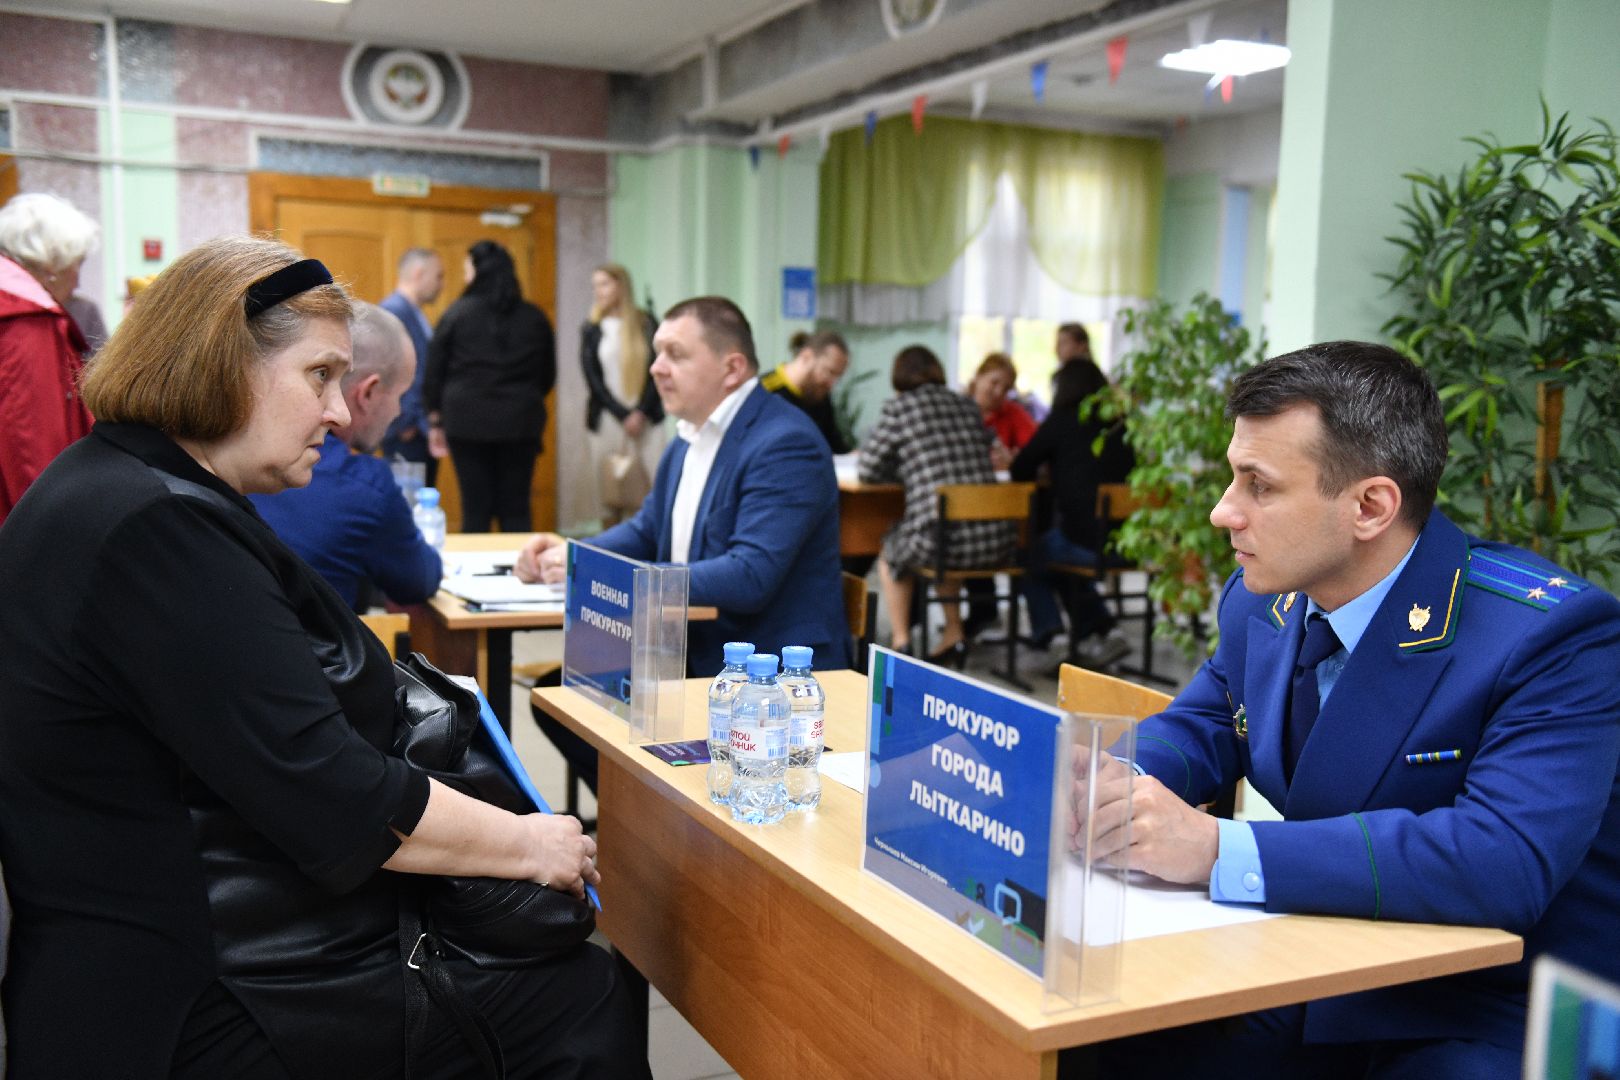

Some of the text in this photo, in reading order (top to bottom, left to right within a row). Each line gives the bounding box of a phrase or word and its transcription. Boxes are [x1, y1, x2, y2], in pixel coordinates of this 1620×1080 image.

[591, 580, 629, 609] ВОЕННАЯ
[581, 605, 632, 642] ПРОКУРАТУР
[923, 693, 1020, 751] ПРОКУРОР
[931, 744, 1004, 797] ГОРОДА
[910, 779, 1025, 857] ЛЫТКАРИНО
